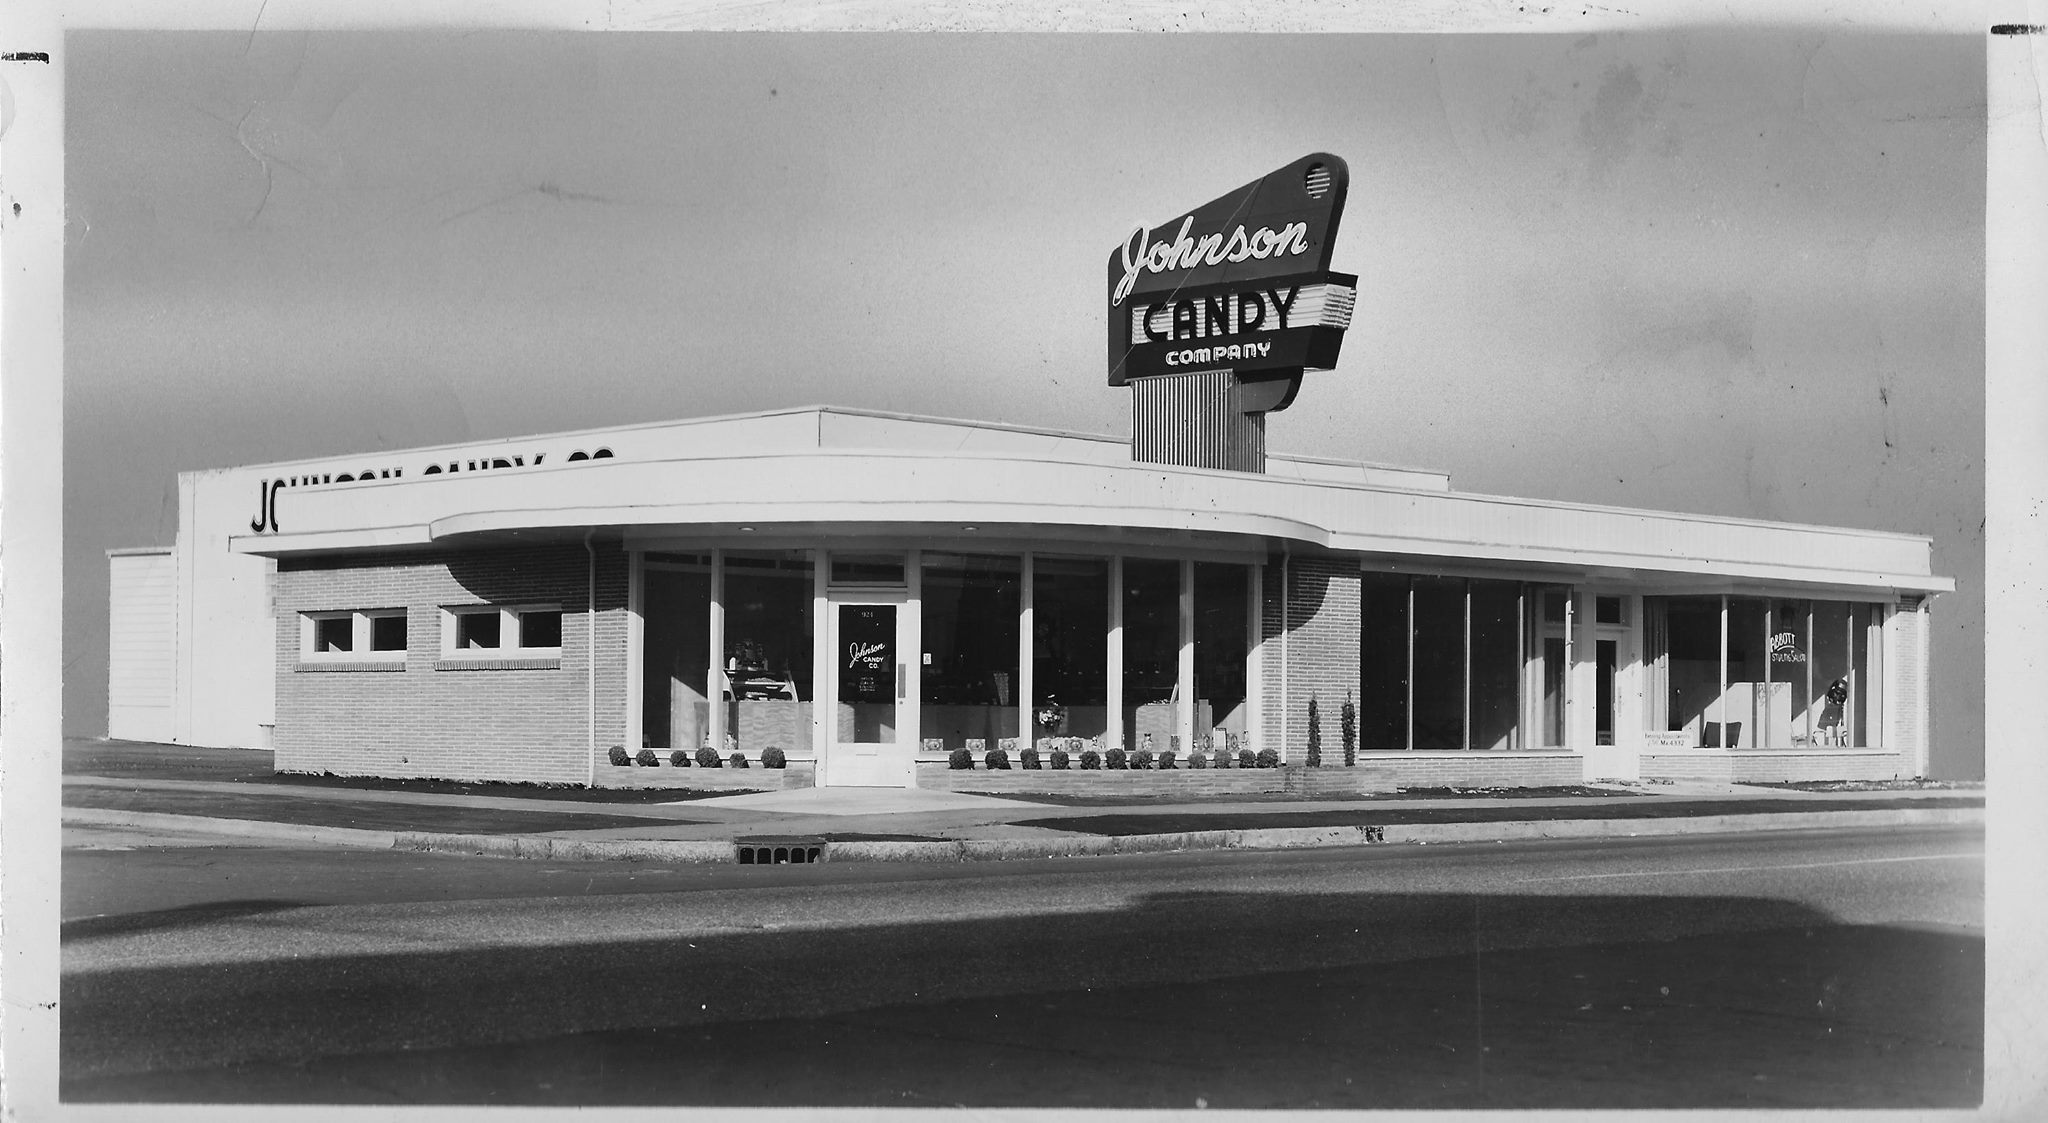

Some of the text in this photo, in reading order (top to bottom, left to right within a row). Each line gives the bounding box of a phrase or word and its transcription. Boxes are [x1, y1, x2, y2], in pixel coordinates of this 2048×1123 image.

[1112, 215, 1308, 307] Johnson
[1142, 286, 1301, 343] CANDY
[1165, 340, 1272, 366] COMPANY
[849, 641, 886, 669] Johnson
[1770, 632, 1796, 653] ABBOTT
